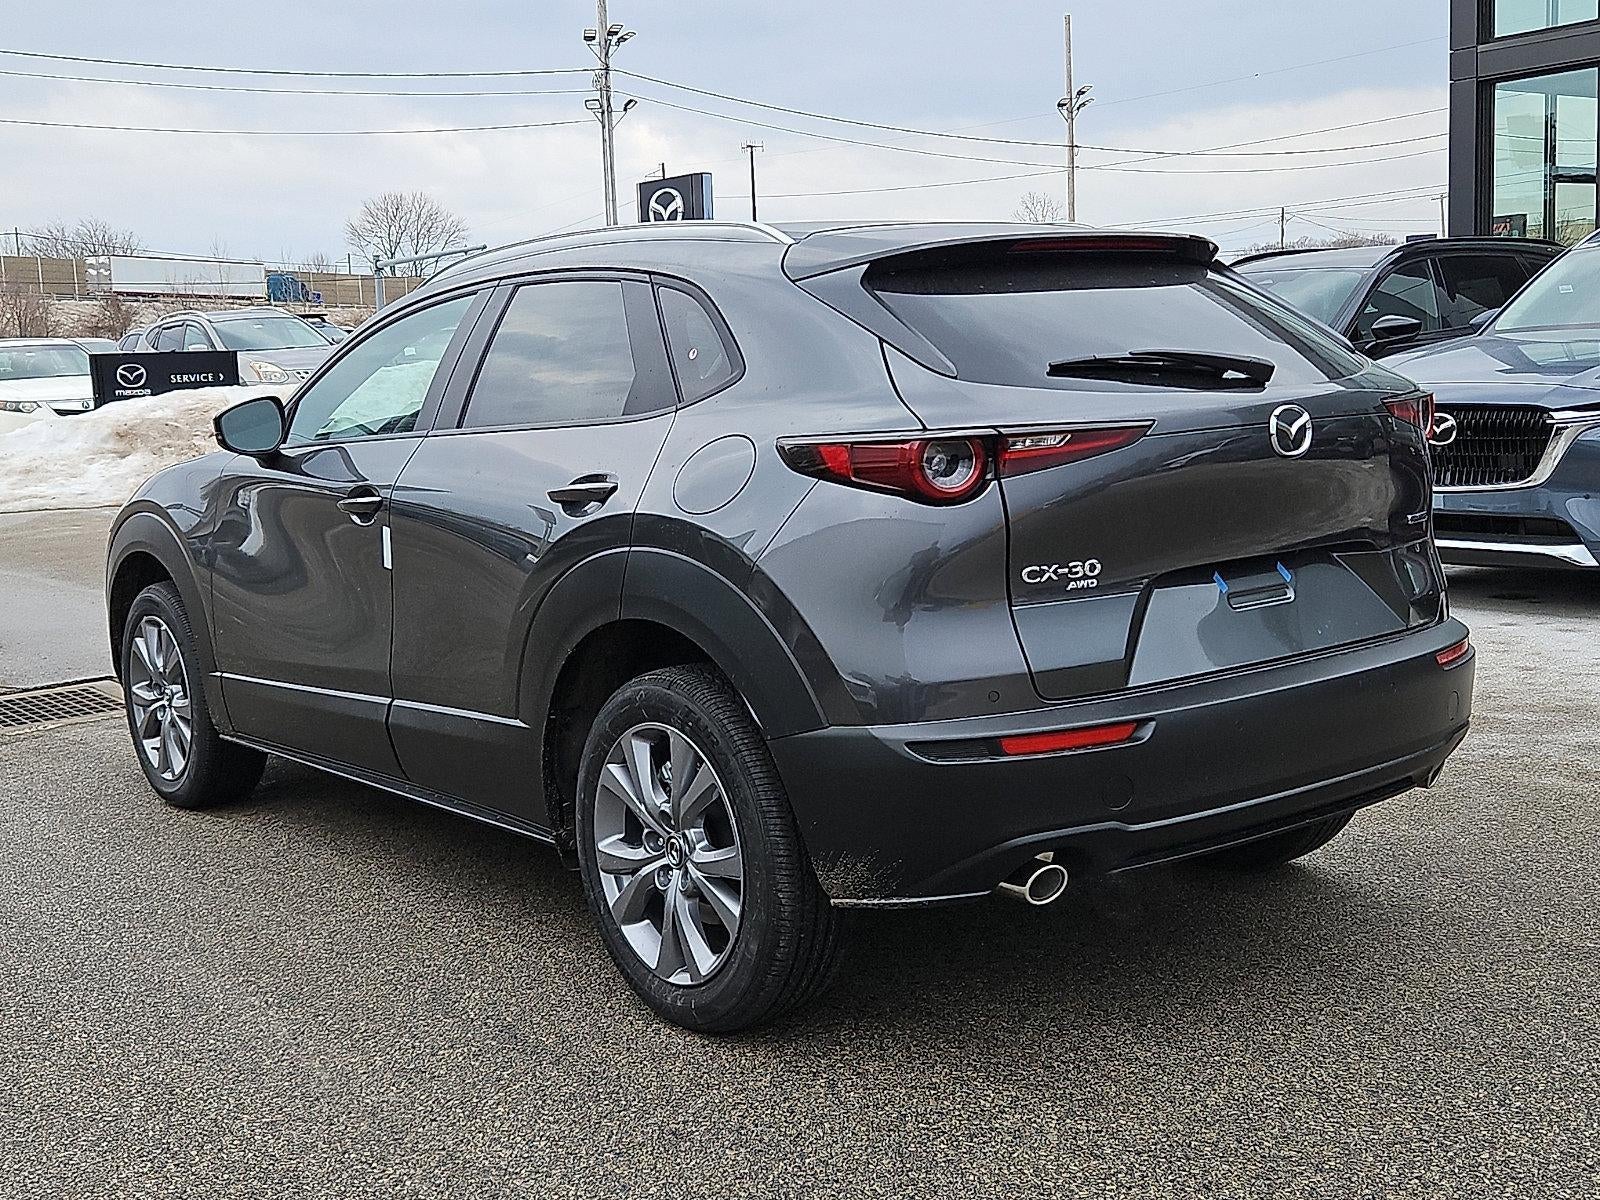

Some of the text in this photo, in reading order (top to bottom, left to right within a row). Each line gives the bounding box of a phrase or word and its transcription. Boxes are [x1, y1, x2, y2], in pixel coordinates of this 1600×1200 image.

[170, 373, 214, 383] SERVICE
[1021, 559, 1101, 583] CX-30
[1066, 579, 1098, 591] AWD
